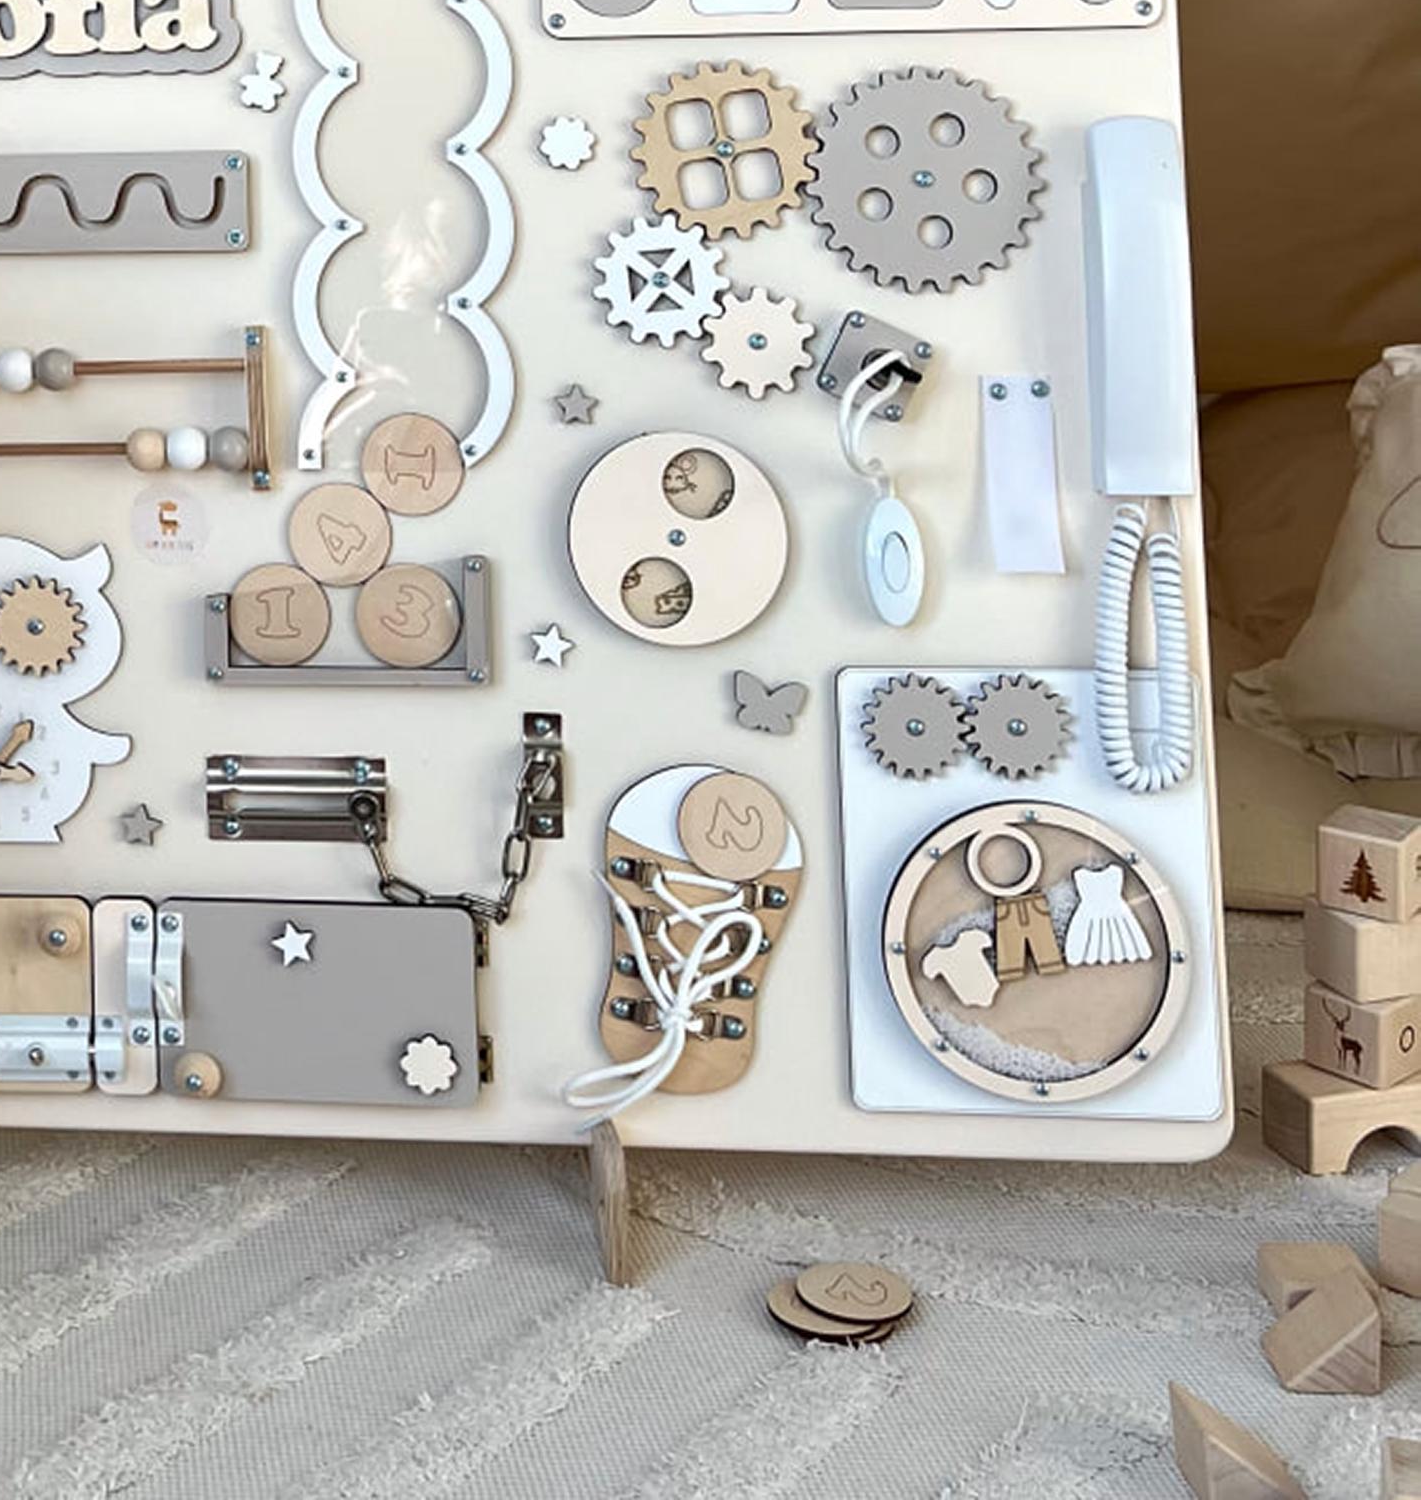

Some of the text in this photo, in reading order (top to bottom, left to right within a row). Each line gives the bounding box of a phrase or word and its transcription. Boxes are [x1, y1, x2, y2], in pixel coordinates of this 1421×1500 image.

[317, 513, 367, 565] 4
[256, 586, 301, 639] 1
[380, 584, 436, 639] 3
[705, 796, 764, 852] 2
[825, 1271, 888, 1307] 2
